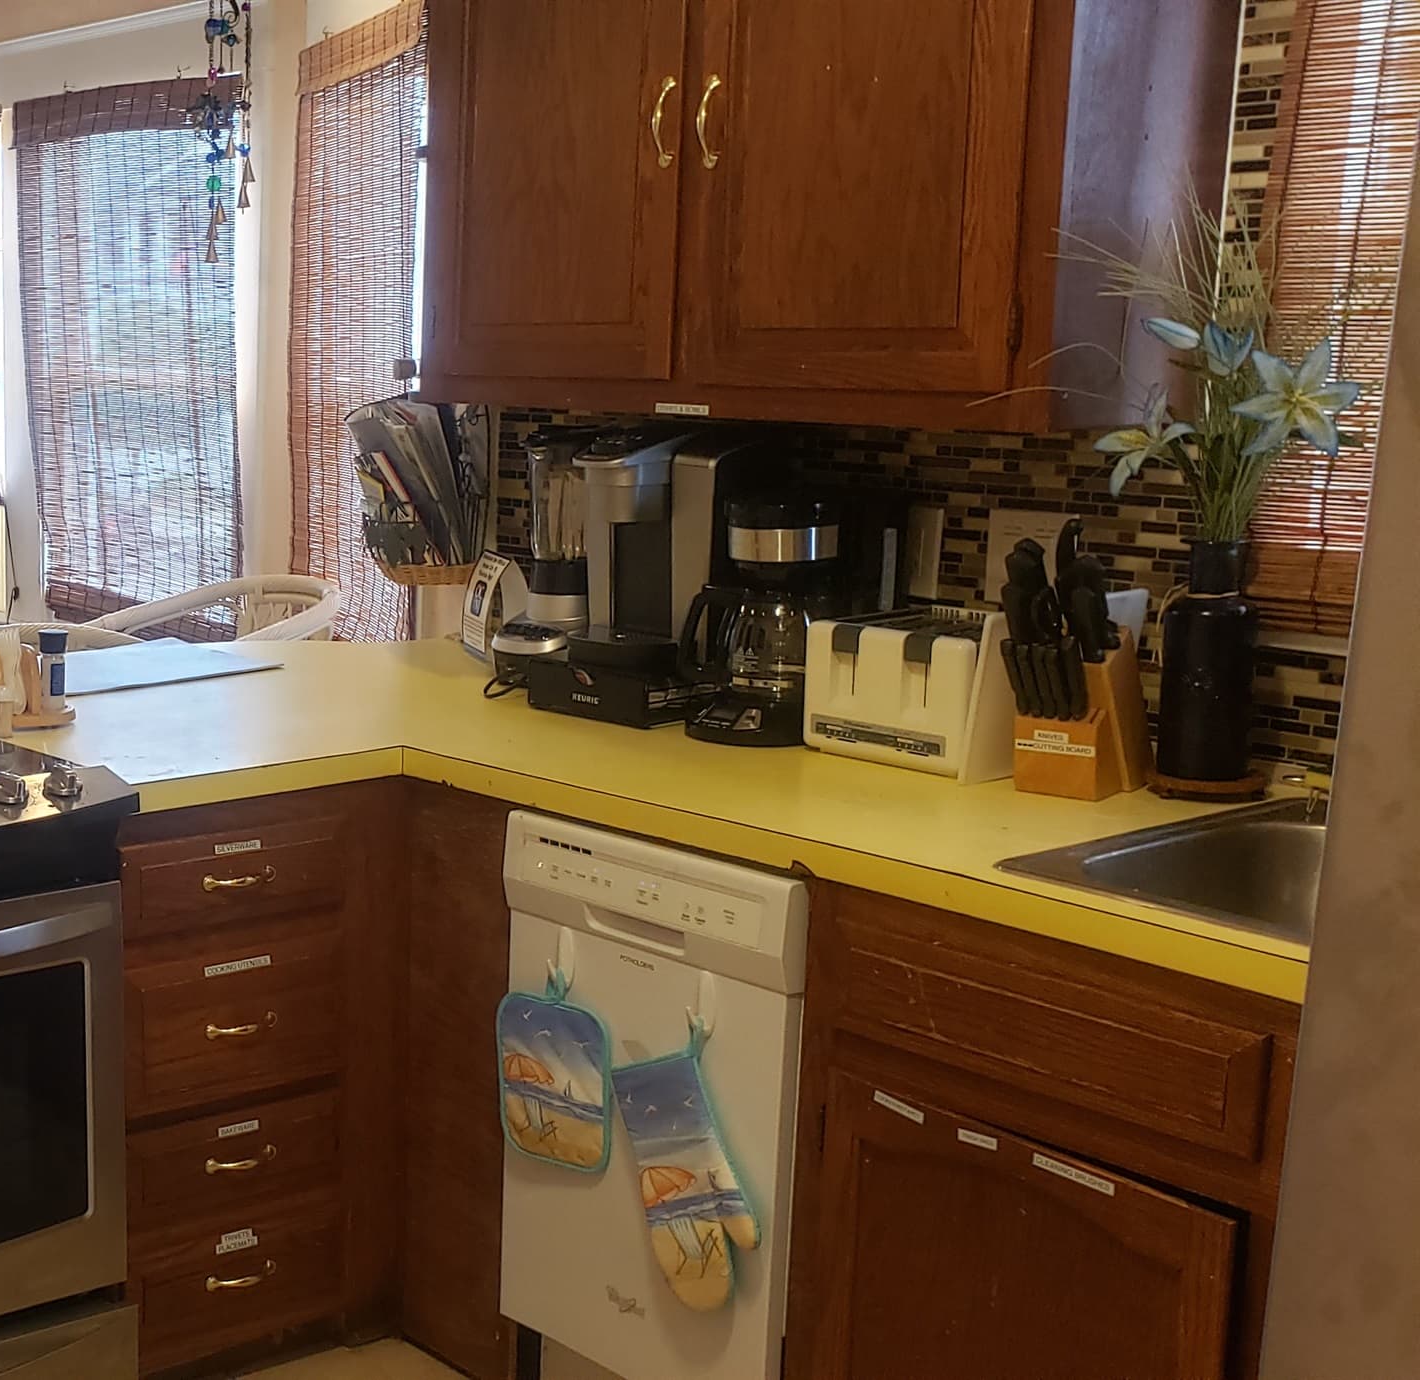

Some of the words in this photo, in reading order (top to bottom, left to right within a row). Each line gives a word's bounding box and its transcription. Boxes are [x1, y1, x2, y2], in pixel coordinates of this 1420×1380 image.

[571, 692, 600, 705] KEURIG
[1065, 746, 1092, 754] BOARD
[216, 841, 259, 853] SILVERWARE
[206, 963, 237, 975] COOKING
[1035, 1156, 1074, 1177] CLEANING
